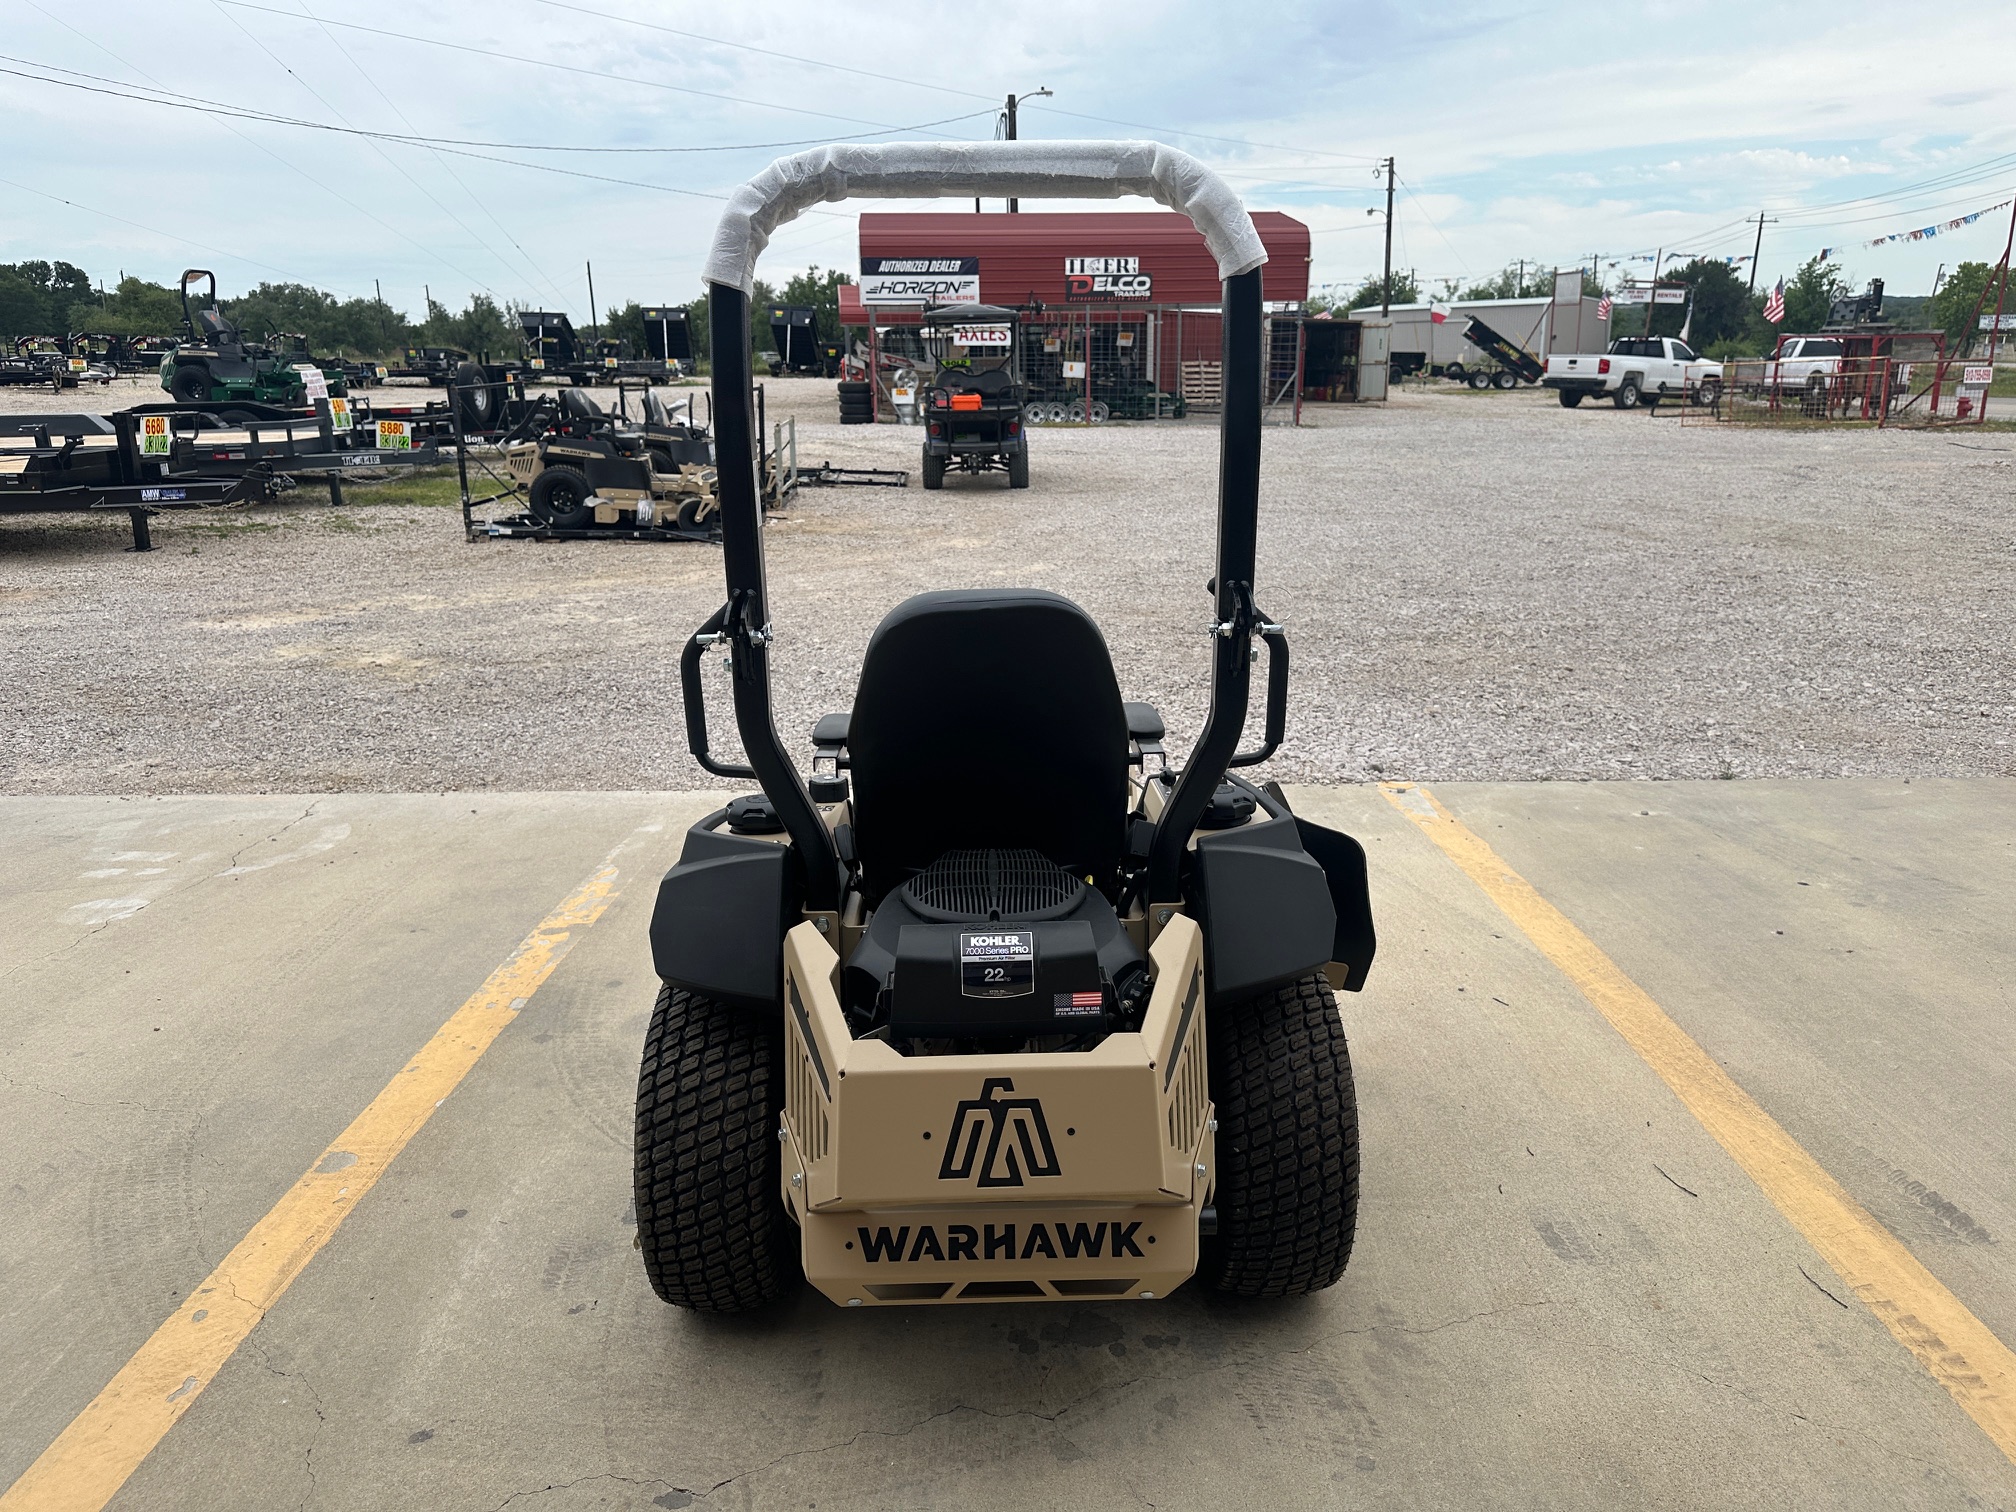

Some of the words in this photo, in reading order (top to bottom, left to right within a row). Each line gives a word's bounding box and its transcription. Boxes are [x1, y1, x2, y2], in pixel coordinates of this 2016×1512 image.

[878, 260, 929, 272] AUTHORIZED
[929, 260, 961, 272] DEALER
[879, 281, 962, 294] HORIZON
[1068, 275, 1151, 294] DELCO
[958, 330, 1008, 342] AXLES
[145, 418, 165, 435] 6680
[380, 422, 404, 435] 5880
[560, 448, 591, 456] WARHAWK
[141, 489, 160, 498] AMW
[965, 947, 985, 955] 7000
[985, 947, 1009, 955] Series
[1010, 946, 1029, 954] PRO
[856, 1221, 1146, 1263] WARHAWK
